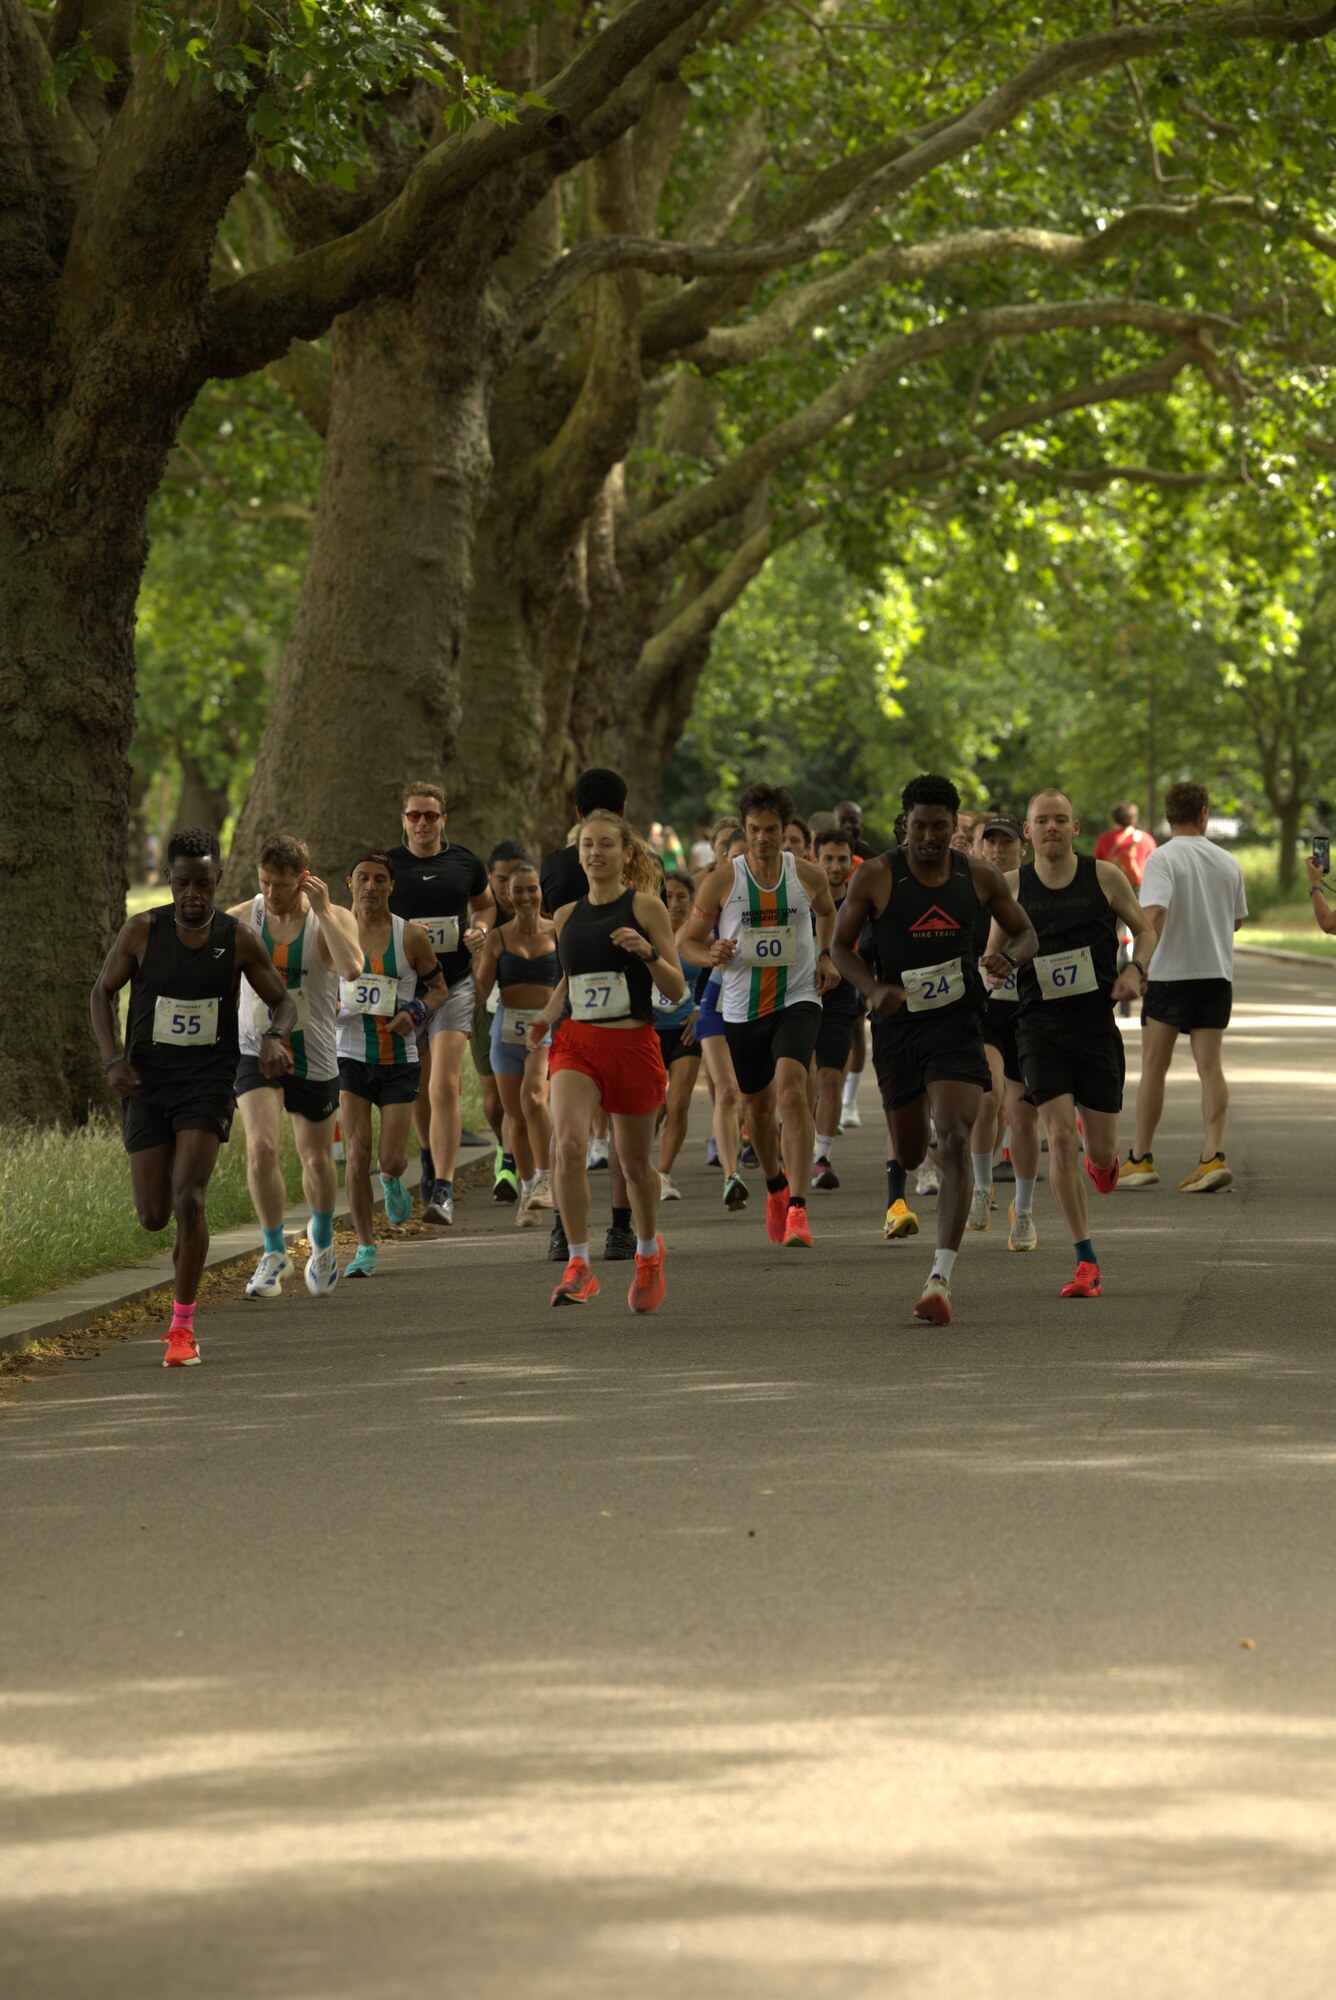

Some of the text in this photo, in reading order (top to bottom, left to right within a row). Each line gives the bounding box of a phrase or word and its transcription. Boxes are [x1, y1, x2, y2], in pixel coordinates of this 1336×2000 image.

[741, 908, 797, 917] MORNINGTON
[741, 914, 778, 923] CHASERS
[755, 939, 782, 957] 60
[1052, 964, 1078, 987] 67
[356, 986, 381, 1005] 30
[584, 986, 611, 1008] 27
[921, 975, 950, 999] 24
[171, 1014, 201, 1035] 55
